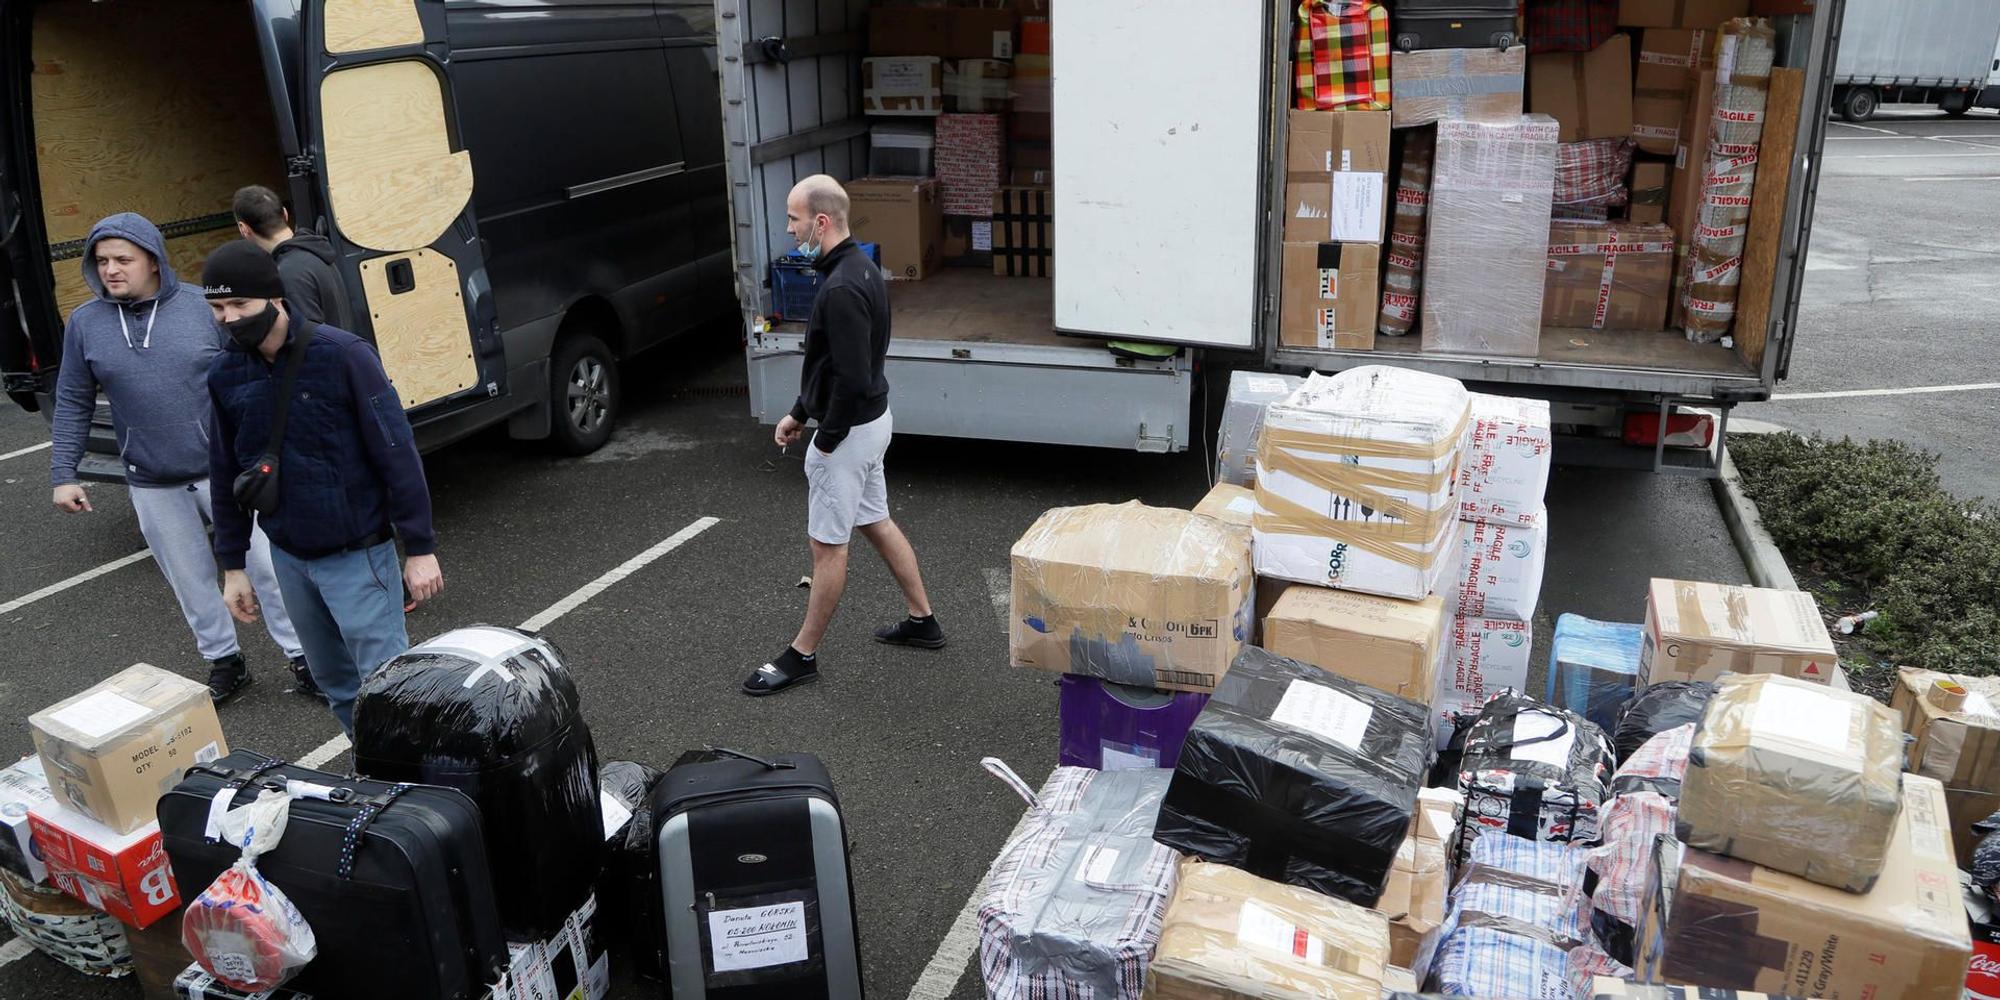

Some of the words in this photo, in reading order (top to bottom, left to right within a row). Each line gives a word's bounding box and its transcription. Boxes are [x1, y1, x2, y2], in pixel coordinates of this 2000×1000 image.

[1597, 244, 1644, 253] FRAGILE
[1594, 284, 1609, 326] FRAGILE
[132, 745, 159, 763] MODEL
[140, 866, 175, 906] B
[1813, 934, 1839, 991] Gray/White
